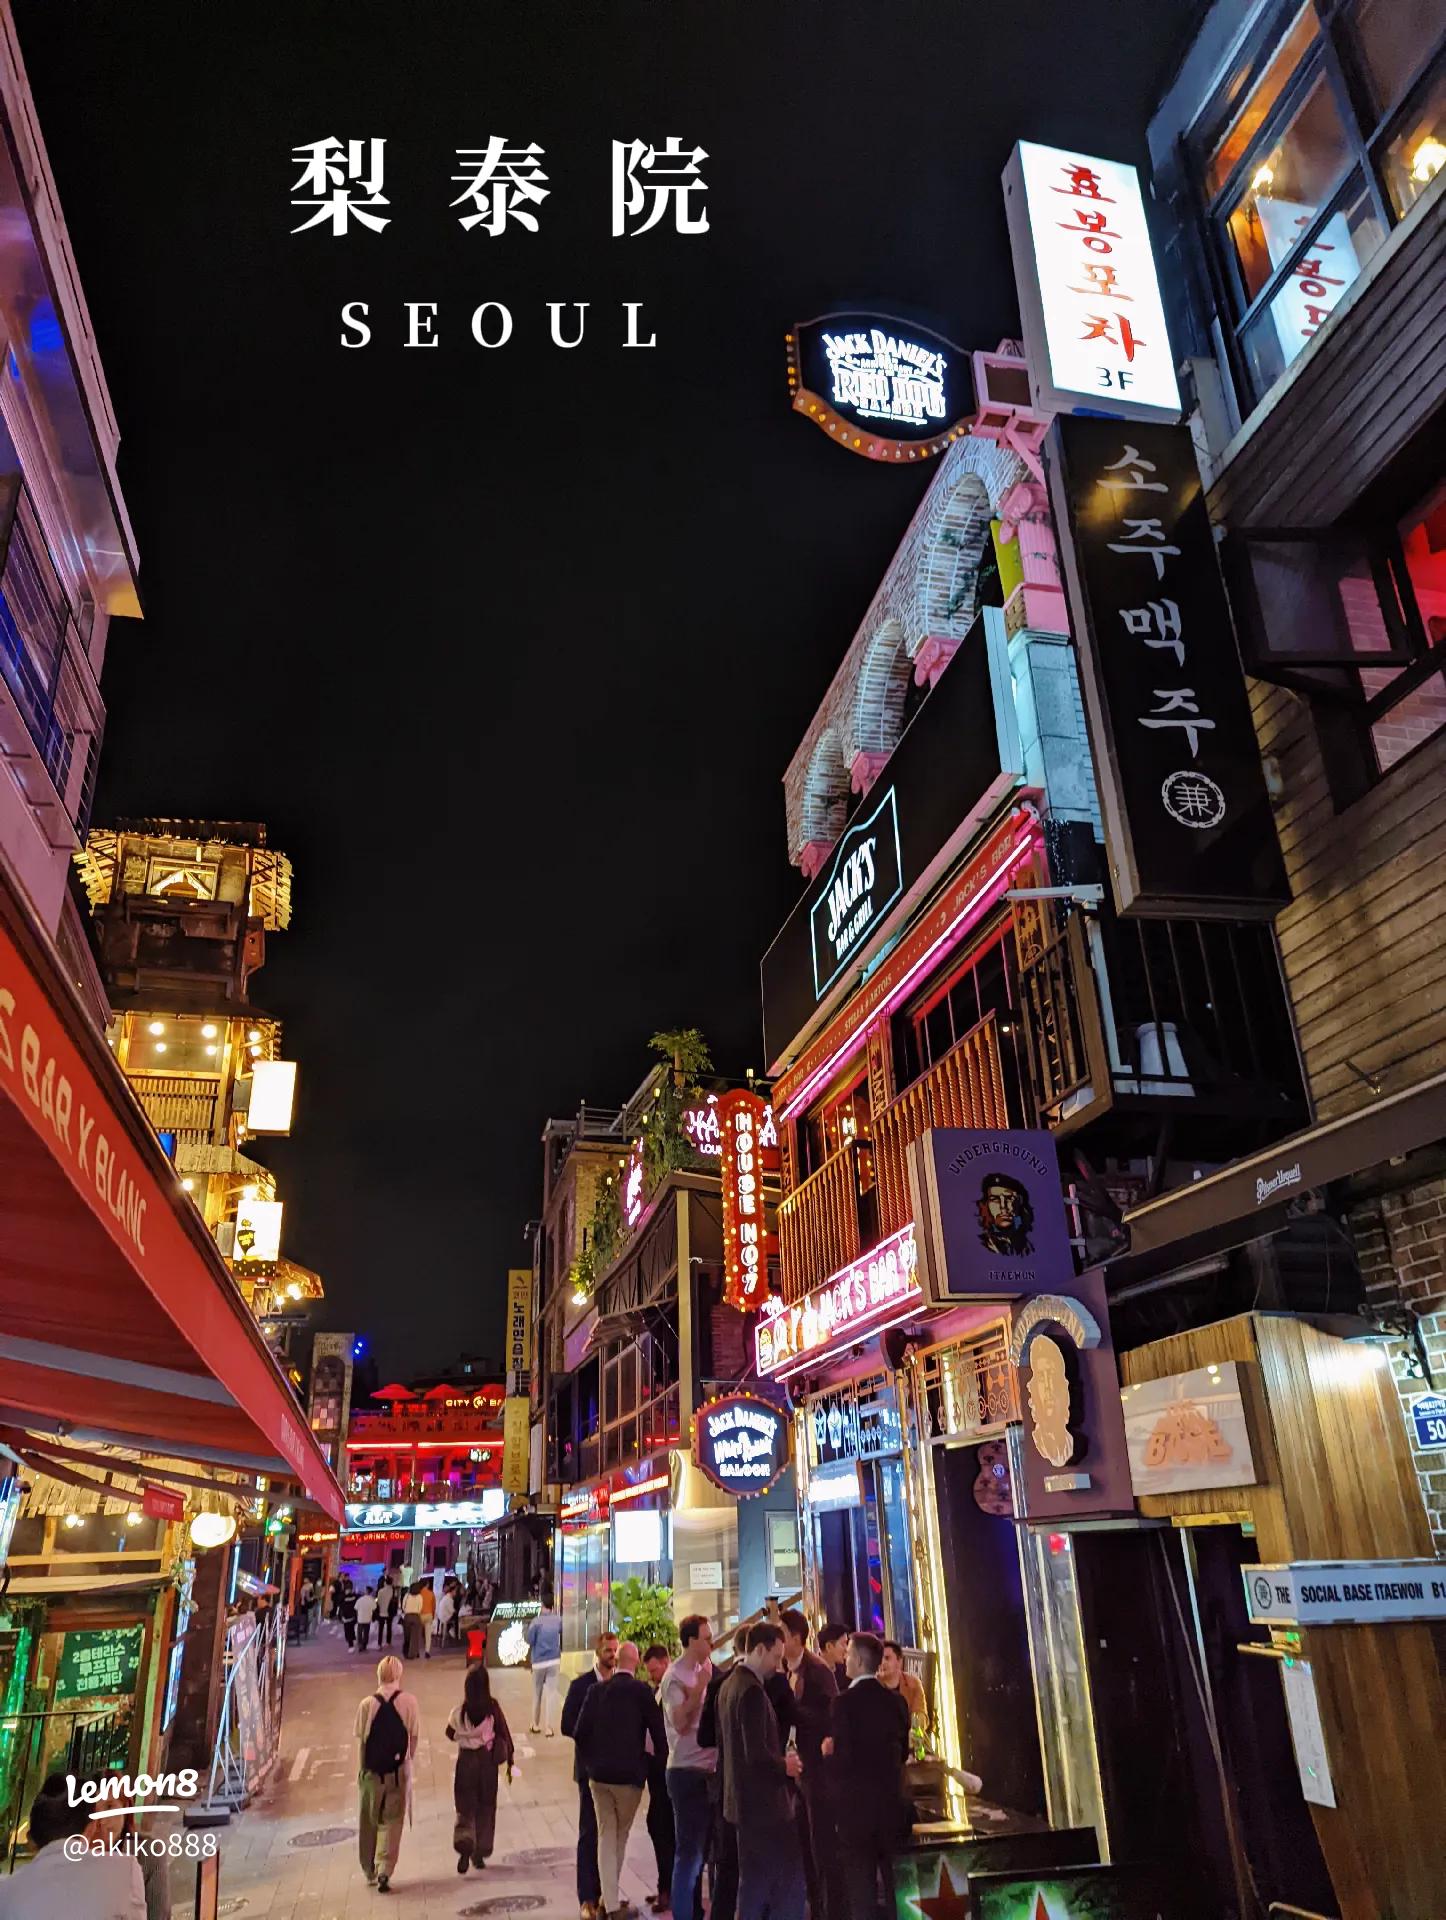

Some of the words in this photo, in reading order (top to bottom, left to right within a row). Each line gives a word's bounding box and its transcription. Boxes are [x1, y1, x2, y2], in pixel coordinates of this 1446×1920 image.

[821, 333, 873, 360] JACK
[870, 329, 948, 380] DANIEL'S
[1096, 366, 1135, 390] 3F
[1096, 445, 1216, 758] 소주맥주
[827, 837, 877, 942] JACK'S
[953, 864, 988, 912] JACK'S
[835, 927, 850, 960] BAR
[853, 895, 874, 935] GRILL
[870, 973, 892, 1006] ARTOIS
[21, 1023, 73, 1156] BAR
[78, 1104, 95, 1181] X
[95, 1133, 147, 1257] BLANC
[735, 1112, 756, 1215] HOUSE
[949, 1141, 1048, 1177] UNDERGROUND
[868, 1250, 901, 1306] BAR
[511, 1302, 525, 1370] 노래연습장
[446, 1399, 470, 1407] CITY
[719, 1464, 771, 1477] SALOON
[1275, 1586, 1291, 1604] THE
[1301, 1585, 1342, 1603] SOCIAL
[1342, 1584, 1374, 1601] BASE
[1374, 1582, 1424, 1600] ITAEWON
